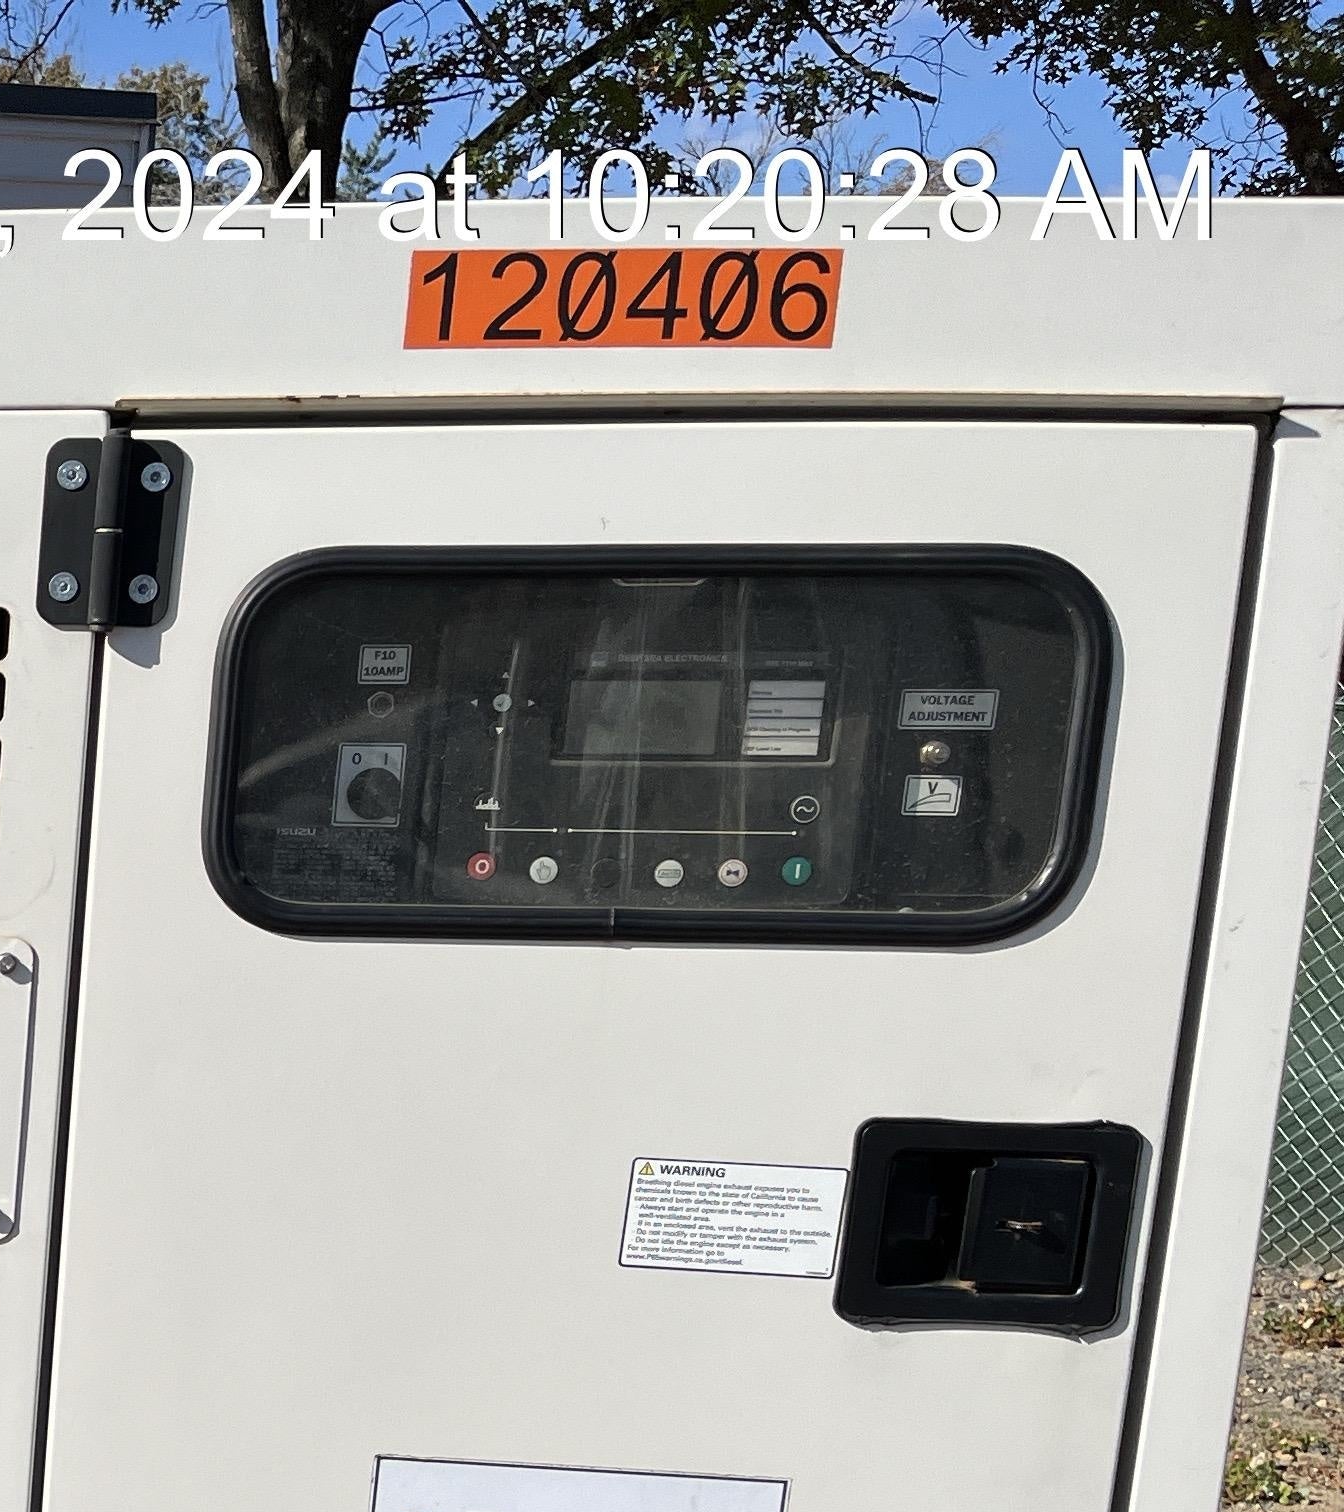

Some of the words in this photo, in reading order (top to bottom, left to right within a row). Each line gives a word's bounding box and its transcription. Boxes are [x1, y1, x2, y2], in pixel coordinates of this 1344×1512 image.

[421, 251, 831, 342] 120406
[374, 650, 397, 660] F10
[363, 666, 405, 677] 10AMP
[920, 695, 976, 706] VOLTAGE
[908, 711, 988, 722] ADJUSTMENT
[928, 781, 938, 794] V
[660, 1164, 726, 1178] WARNING
[735, 1225, 748, 1233] the
[661, 1246, 704, 1254] information
